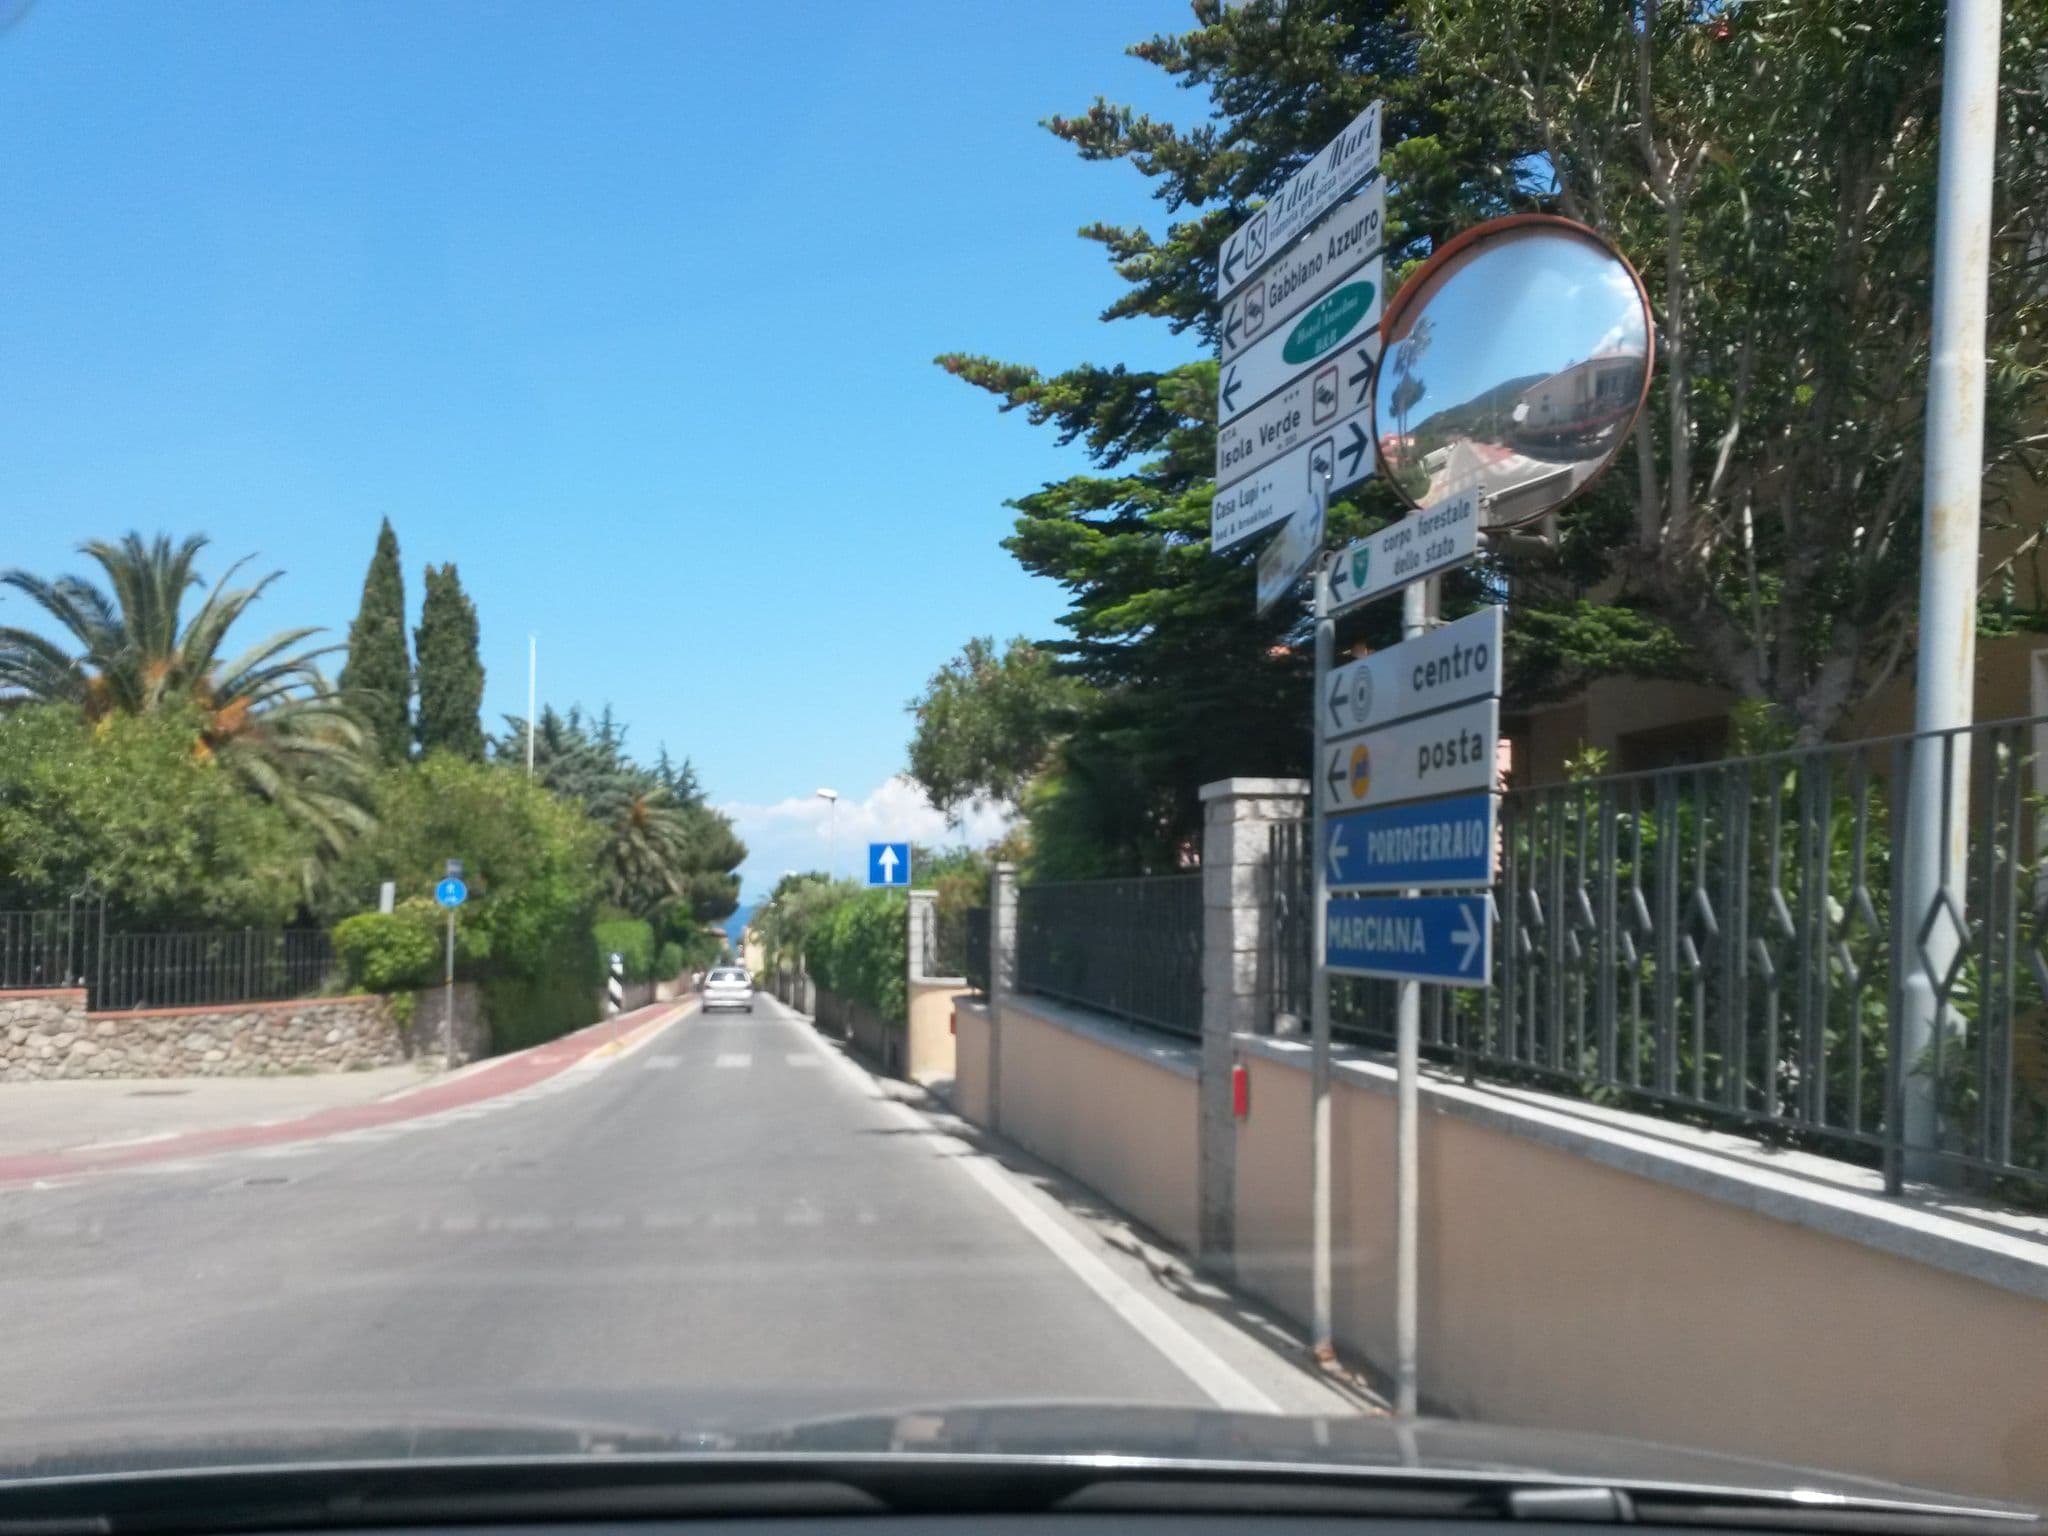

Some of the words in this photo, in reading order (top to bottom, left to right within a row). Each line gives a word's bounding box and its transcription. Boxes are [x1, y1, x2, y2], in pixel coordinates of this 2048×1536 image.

[1269, 253, 1323, 309] Gabbiano
[1327, 208, 1379, 265] Azzurro
[1220, 437, 1253, 470] Isola
[1259, 409, 1301, 447] Verde
[1383, 527, 1412, 552] corpo
[1418, 499, 1471, 537] forestale
[1425, 536, 1455, 562] stato
[1412, 642, 1488, 691] centro
[1418, 728, 1483, 779] posta
[1368, 819, 1484, 865] PORTOFERRAIO
[1327, 917, 1426, 954] MARCIANA
